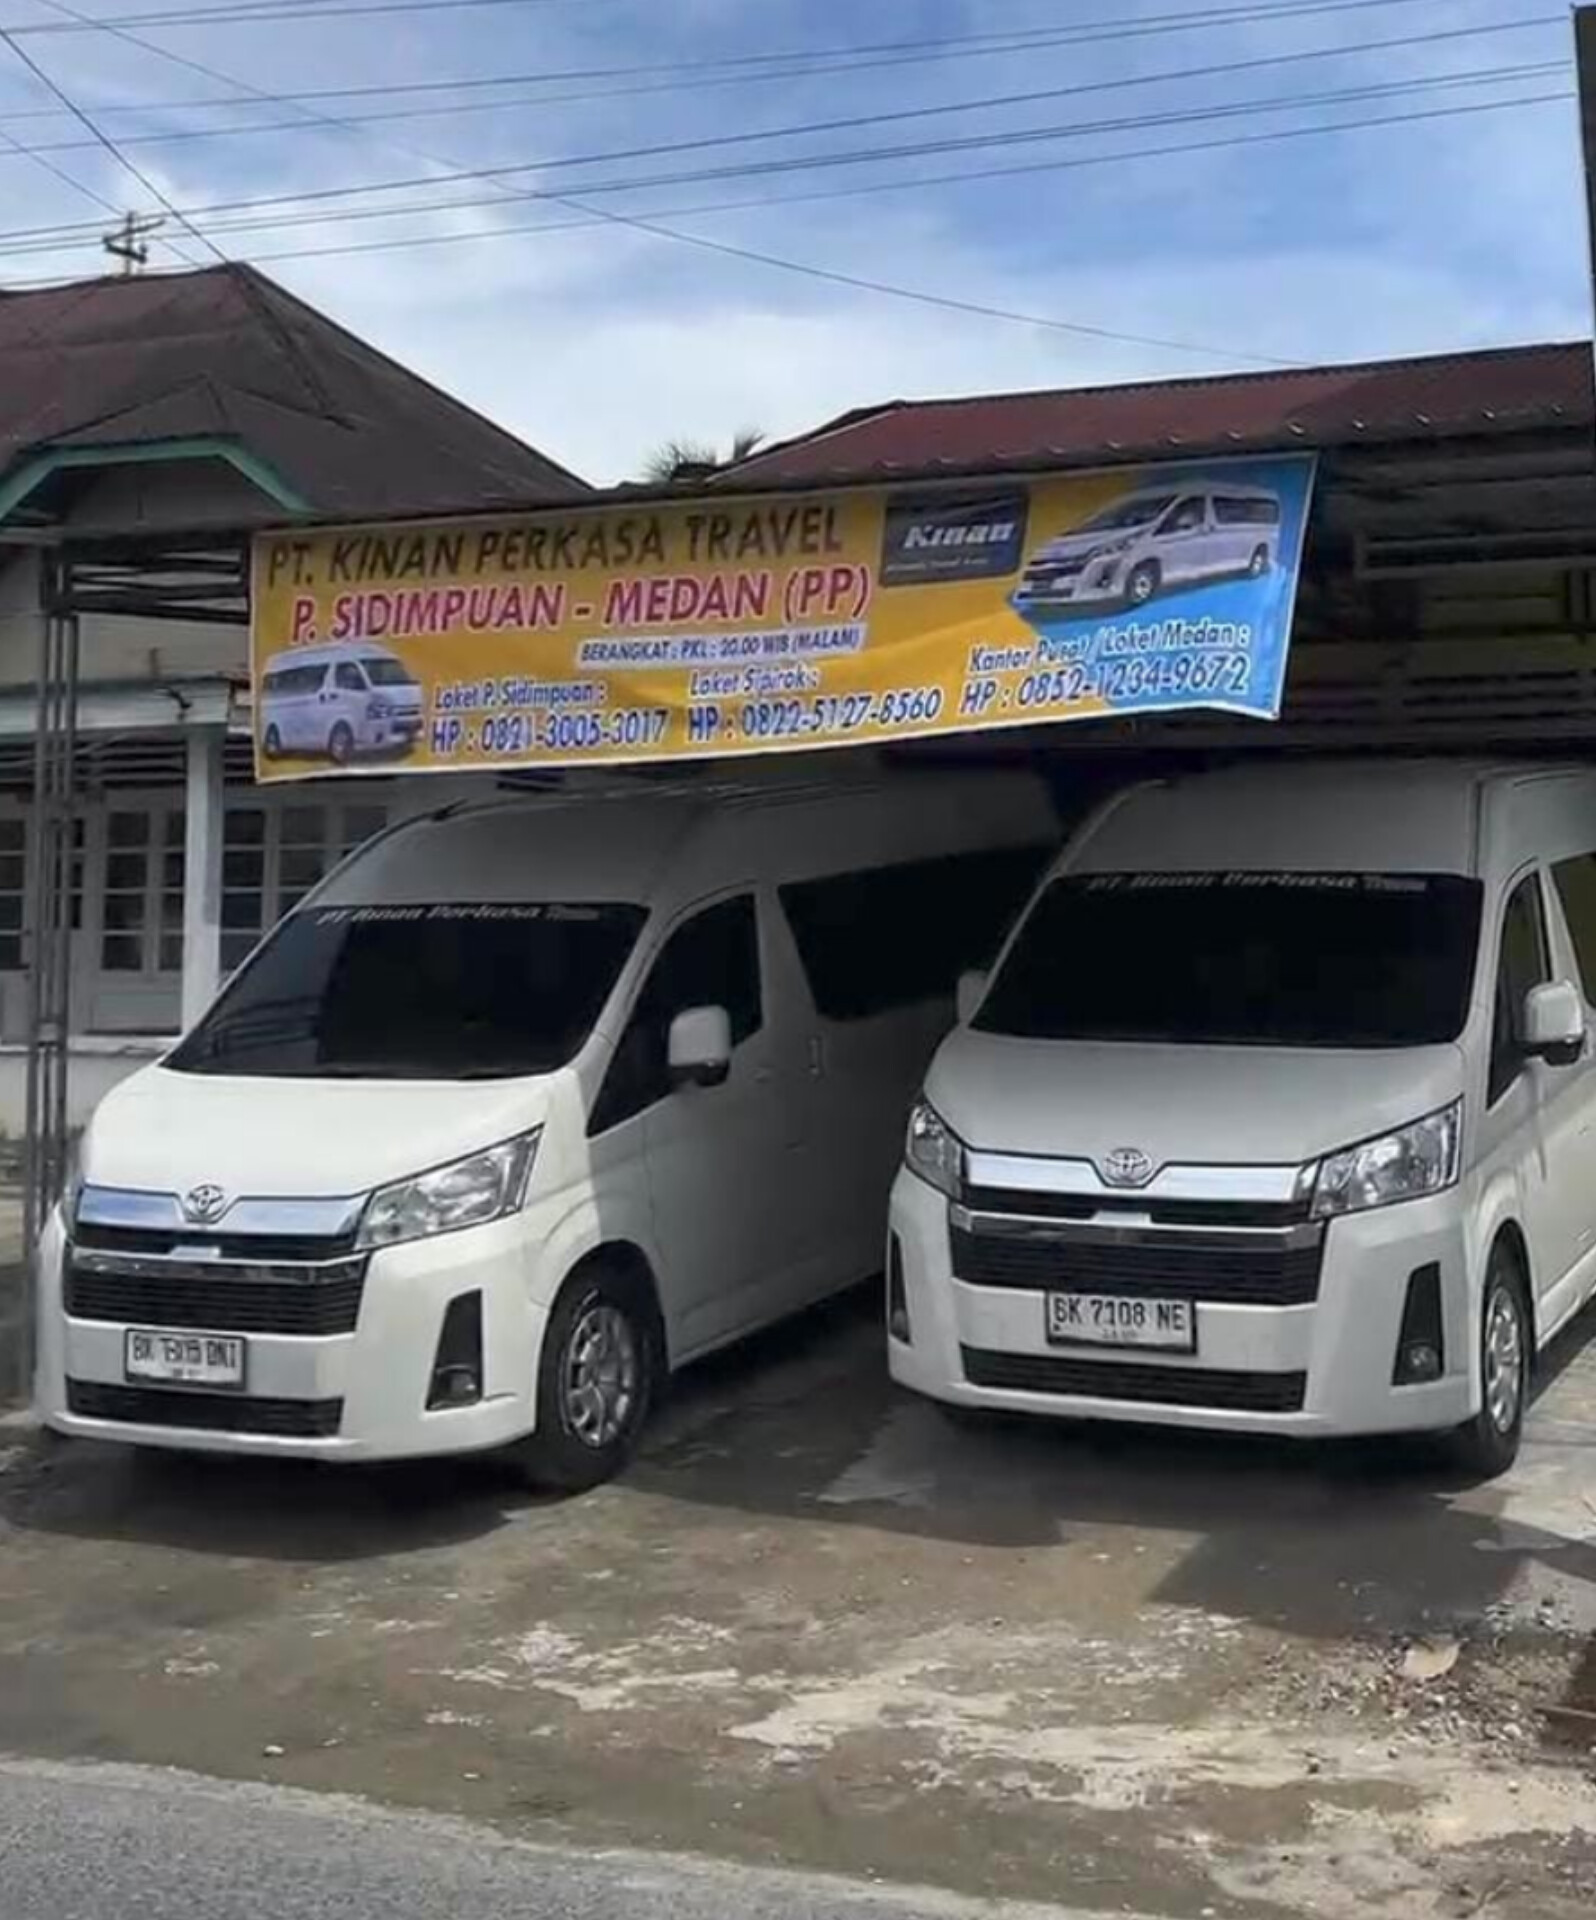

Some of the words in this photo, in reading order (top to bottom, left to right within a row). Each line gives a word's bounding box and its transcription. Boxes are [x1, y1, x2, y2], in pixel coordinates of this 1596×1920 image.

[268, 541, 315, 589] PT.
[328, 534, 465, 584] KINAN
[475, 515, 665, 575] PERKASA
[685, 505, 844, 563] TRAVEL
[903, 522, 1015, 549] Kinan
[292, 599, 317, 643] P.
[332, 583, 564, 639] SIDIMPUAN
[604, 572, 769, 624] MEDAN
[784, 565, 870, 622] (PP)
[960, 681, 998, 714] HP
[433, 720, 461, 752] HP
[688, 706, 718, 740] HP
[1090, 1299, 1146, 1327] 7108
[1157, 1303, 1186, 1331] NE
